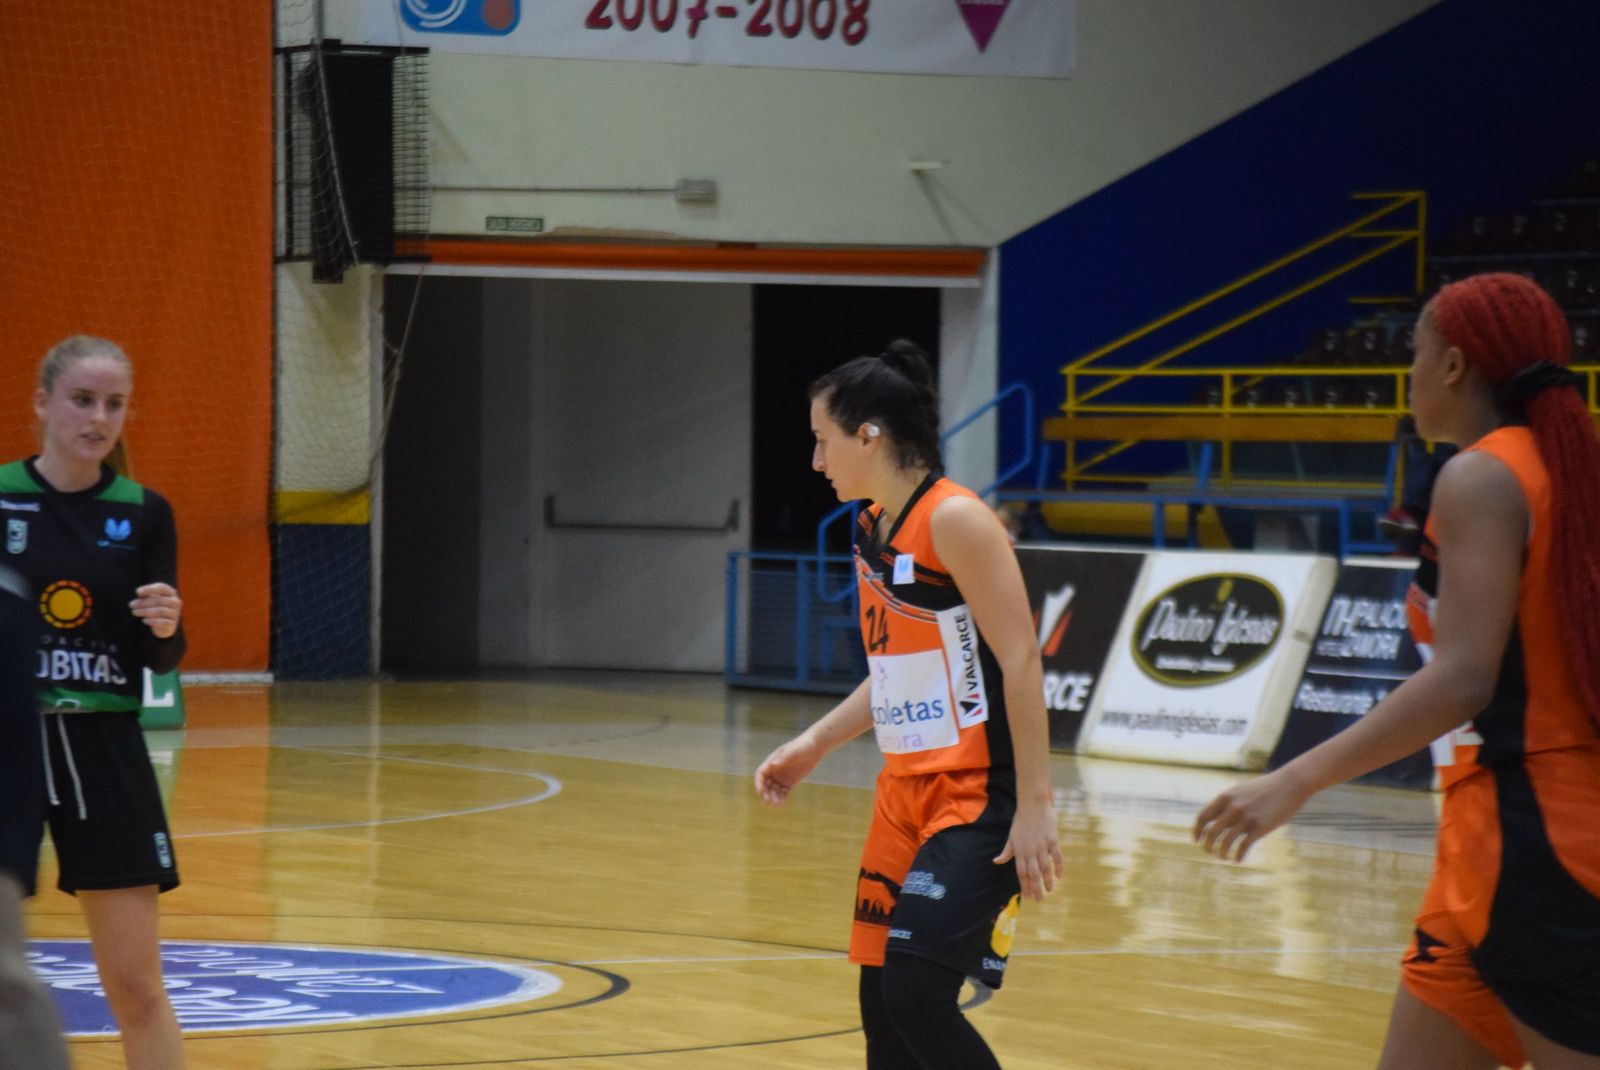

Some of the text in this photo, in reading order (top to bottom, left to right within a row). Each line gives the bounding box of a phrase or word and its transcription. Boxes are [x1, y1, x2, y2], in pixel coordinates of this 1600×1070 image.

[584, 0, 869, 46] 2007-2008
[866, 604, 889, 654] 24
[954, 613, 979, 692] VALCARCE
